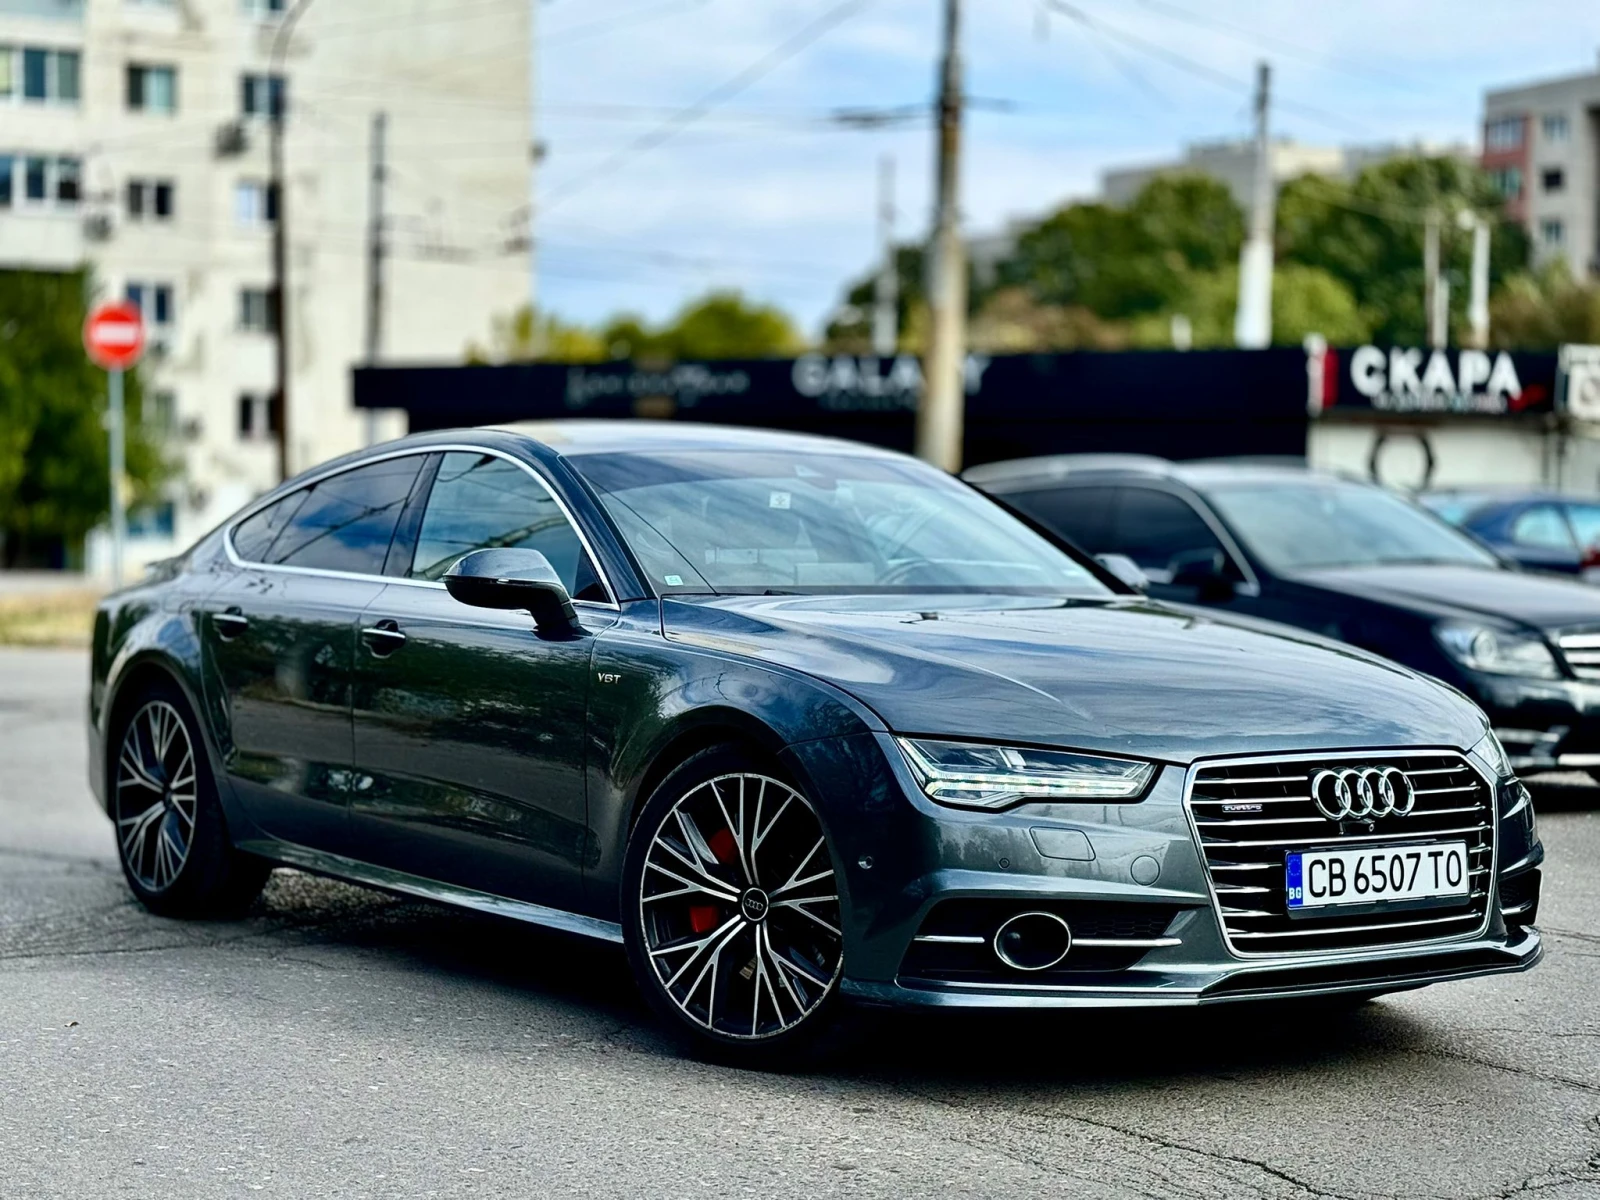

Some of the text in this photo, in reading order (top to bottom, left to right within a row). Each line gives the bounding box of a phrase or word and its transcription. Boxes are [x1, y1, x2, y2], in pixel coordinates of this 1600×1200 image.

[792, 353, 988, 397] GALAY
[1351, 345, 1522, 401] СКАРА
[1288, 887, 1302, 900] BG
[1309, 850, 1462, 898] CB 6507 TO
